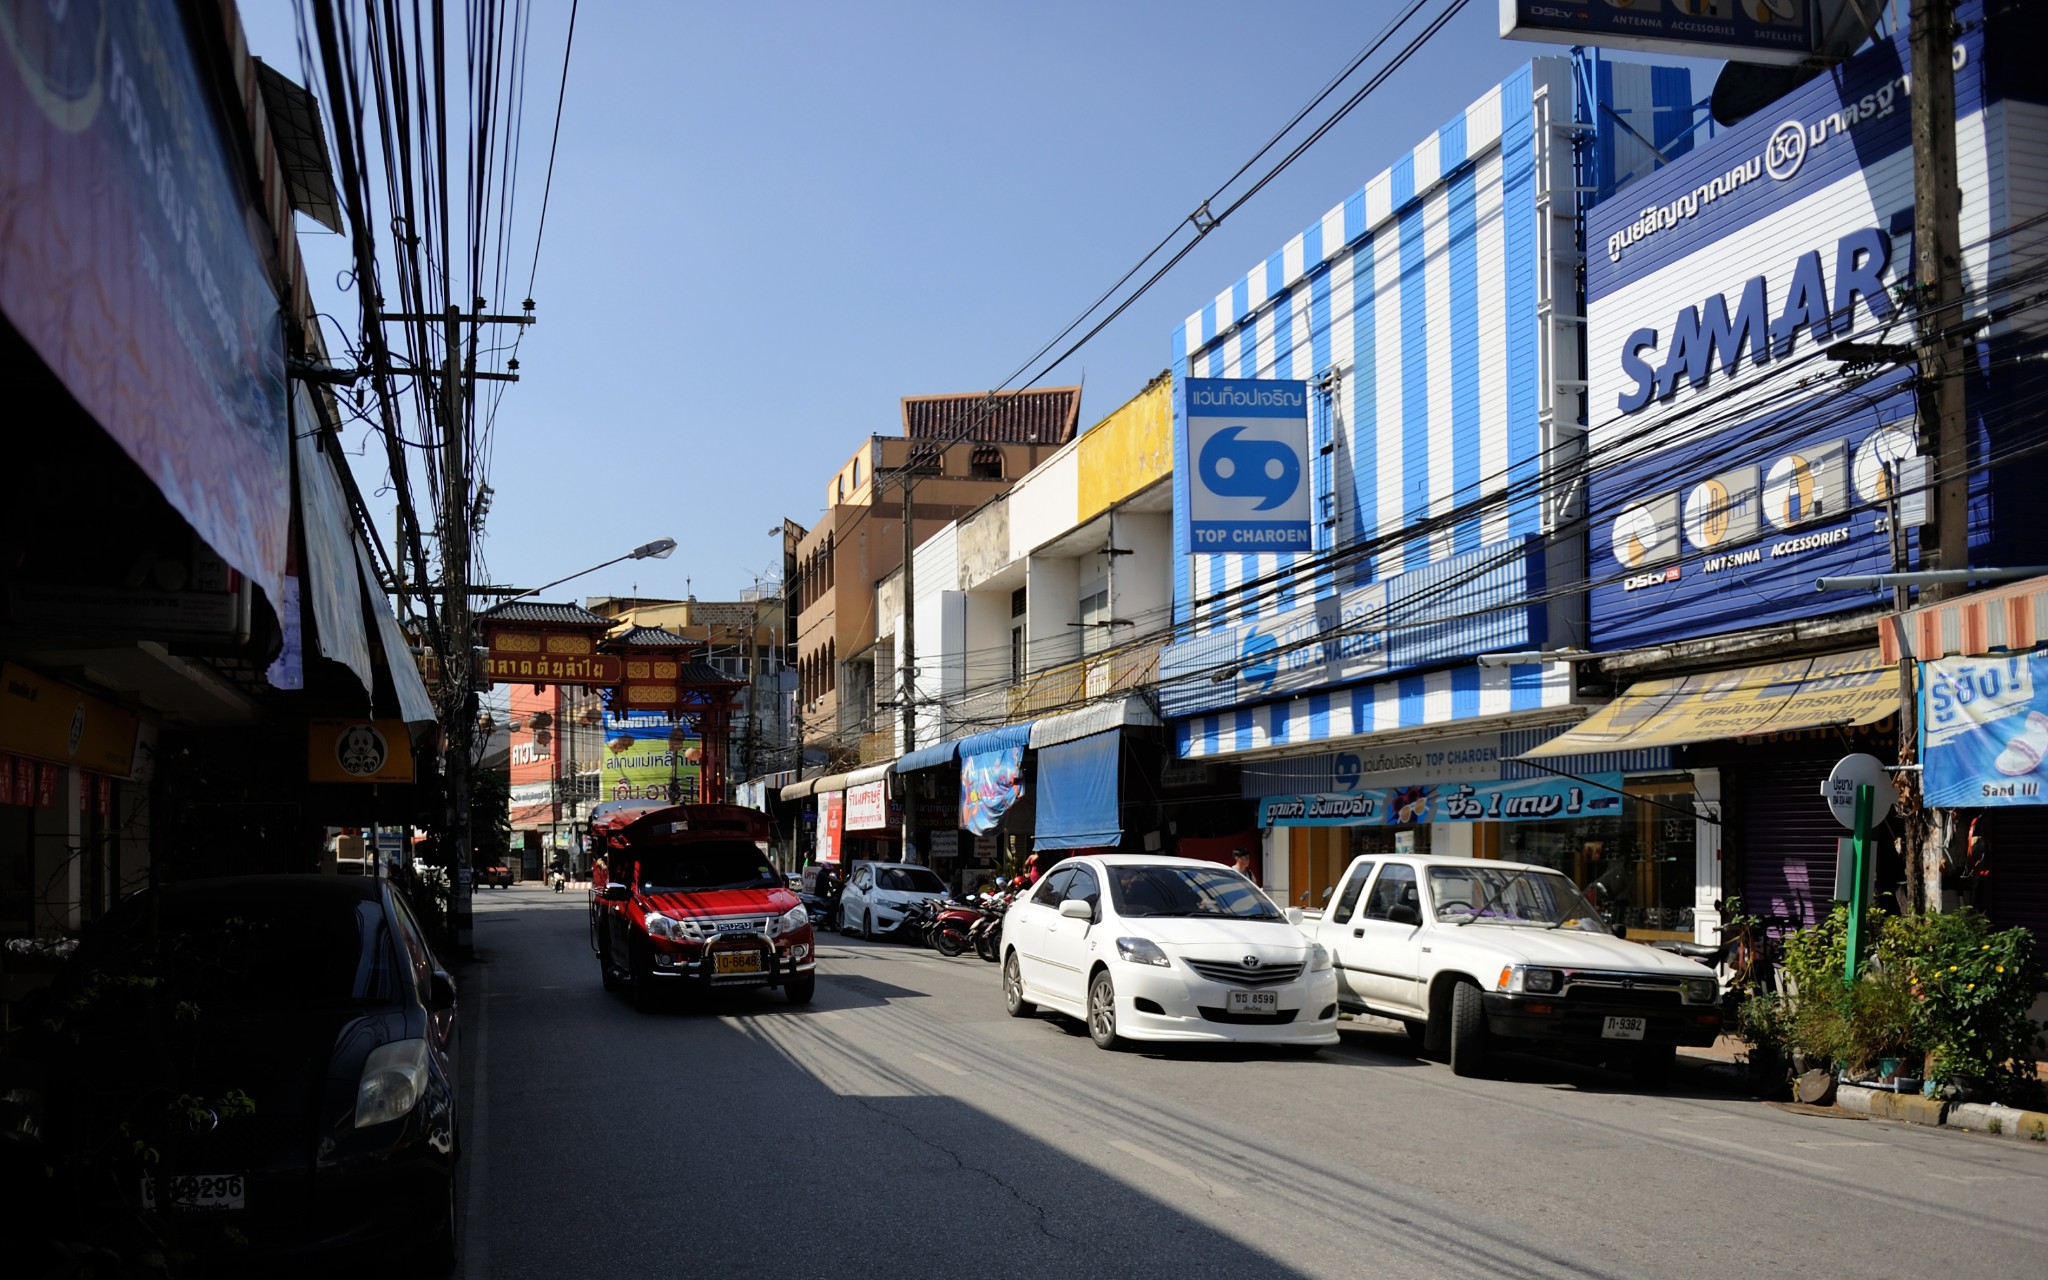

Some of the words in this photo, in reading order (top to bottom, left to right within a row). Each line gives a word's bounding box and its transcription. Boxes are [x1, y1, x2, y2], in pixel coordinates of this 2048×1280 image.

[1613, 15, 1662, 28] ANTENNA
[1671, 21, 1735, 35] ACCESSORIES
[1754, 30, 1804, 43] SATELLITE
[1608, 154, 1761, 262] ศูนย์สัญญาณคม
[1193, 386, 1302, 406] แว่นท็อปเจริญ
[1196, 529, 1227, 543] TOP
[1232, 529, 1308, 543] CHAROEN
[1704, 549, 1761, 572] ANTENNA
[1770, 528, 1849, 557] ACCESSORIES
[1287, 648, 1311, 672] TOP
[1314, 632, 1384, 665] CHAROEN
[1364, 754, 1421, 772] แว่นท็อปเจริญ
[1426, 753, 1444, 767] TOP
[1448, 748, 1497, 764] CHAROEN
[1447, 785, 1481, 815] ซื้อ
[1488, 793, 1500, 815] 1
[1506, 795, 1558, 816] แถม
[1567, 788, 1580, 811] 1
[1982, 784, 2015, 797] Sand
[1266, 795, 1305, 823] ถูกแล้ว
[718, 922, 751, 930] ISUZU
[1253, 994, 1274, 1004] 8599
